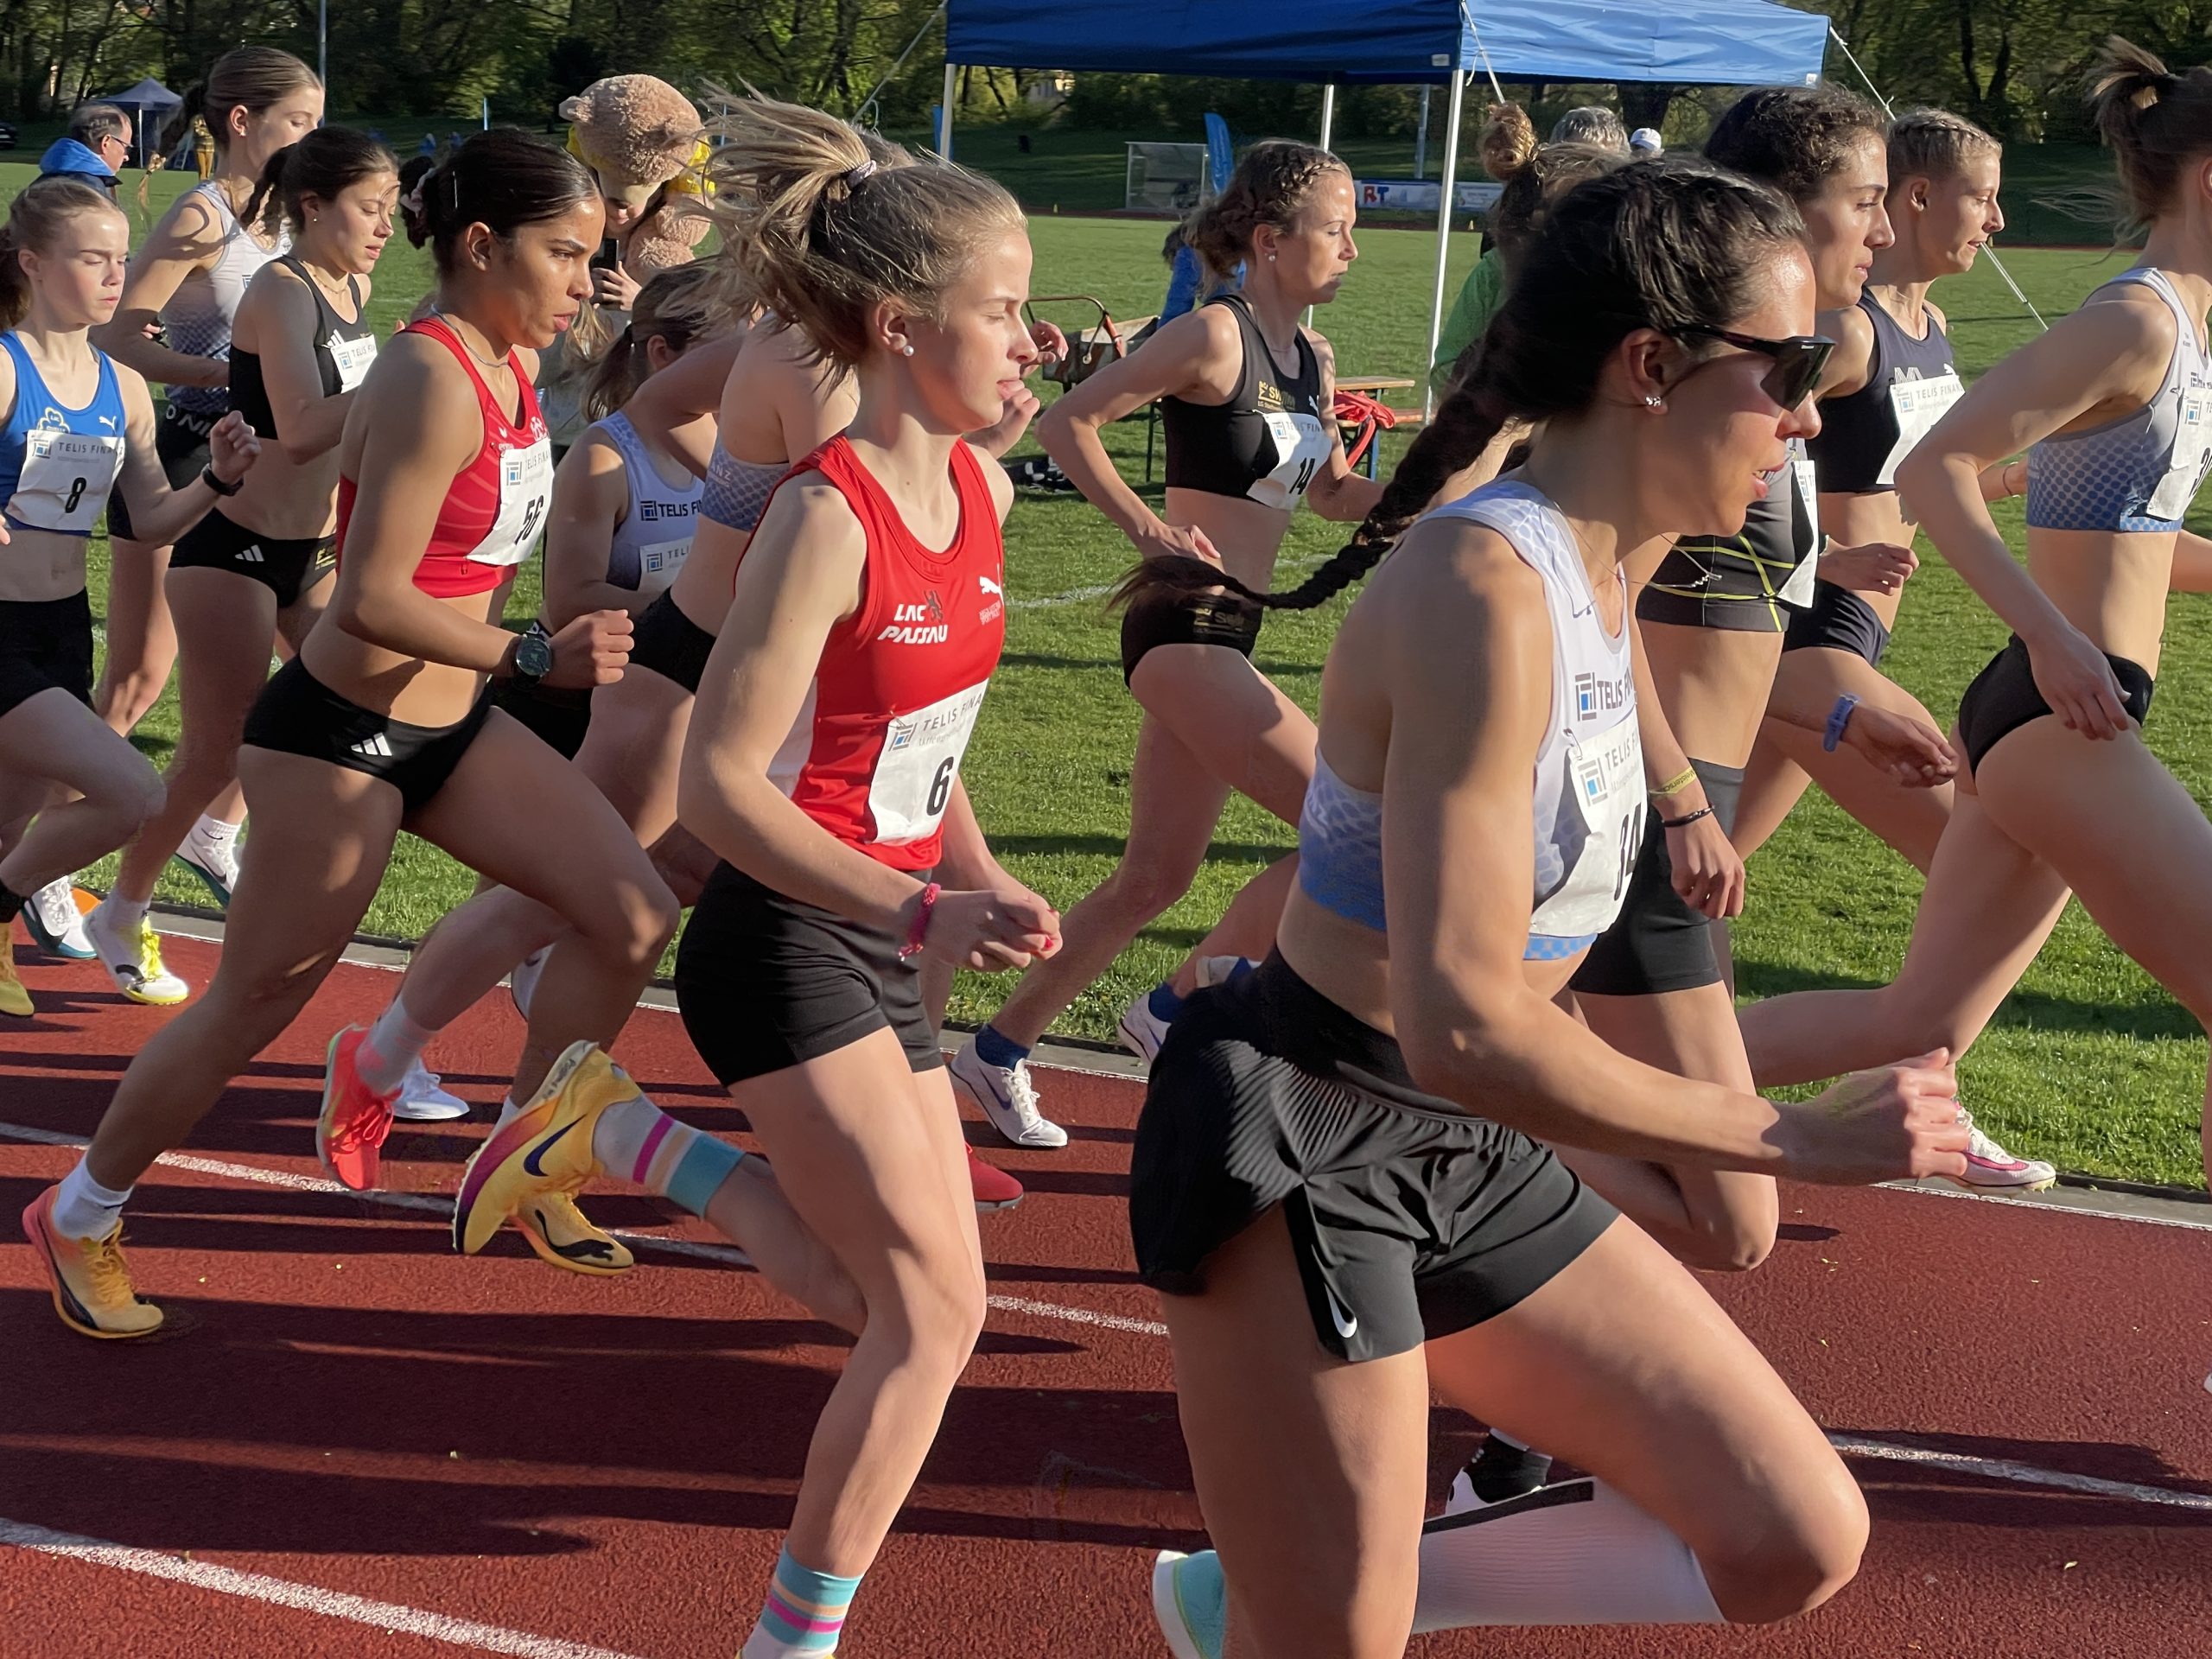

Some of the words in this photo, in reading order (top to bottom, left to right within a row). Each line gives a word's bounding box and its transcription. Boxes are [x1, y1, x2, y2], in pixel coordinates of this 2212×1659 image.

[1916, 387, 1937, 400] TELIS
[177, 413, 213, 438] NI
[58, 442, 87, 454] TELIS
[1288, 457, 1316, 495] 14
[65, 477, 87, 513] 8
[658, 503, 689, 518] TELIS
[691, 499, 702, 515] FI
[514, 494, 544, 546] 56
[668, 545, 690, 560] TELI
[893, 603, 927, 621] LAC
[877, 624, 949, 645] PASSAU
[1597, 678, 1624, 710] TELIS
[923, 707, 957, 732] TELIS
[960, 692, 982, 717] FINA
[1605, 737, 1630, 772] TELIS
[926, 756, 955, 817] 6
